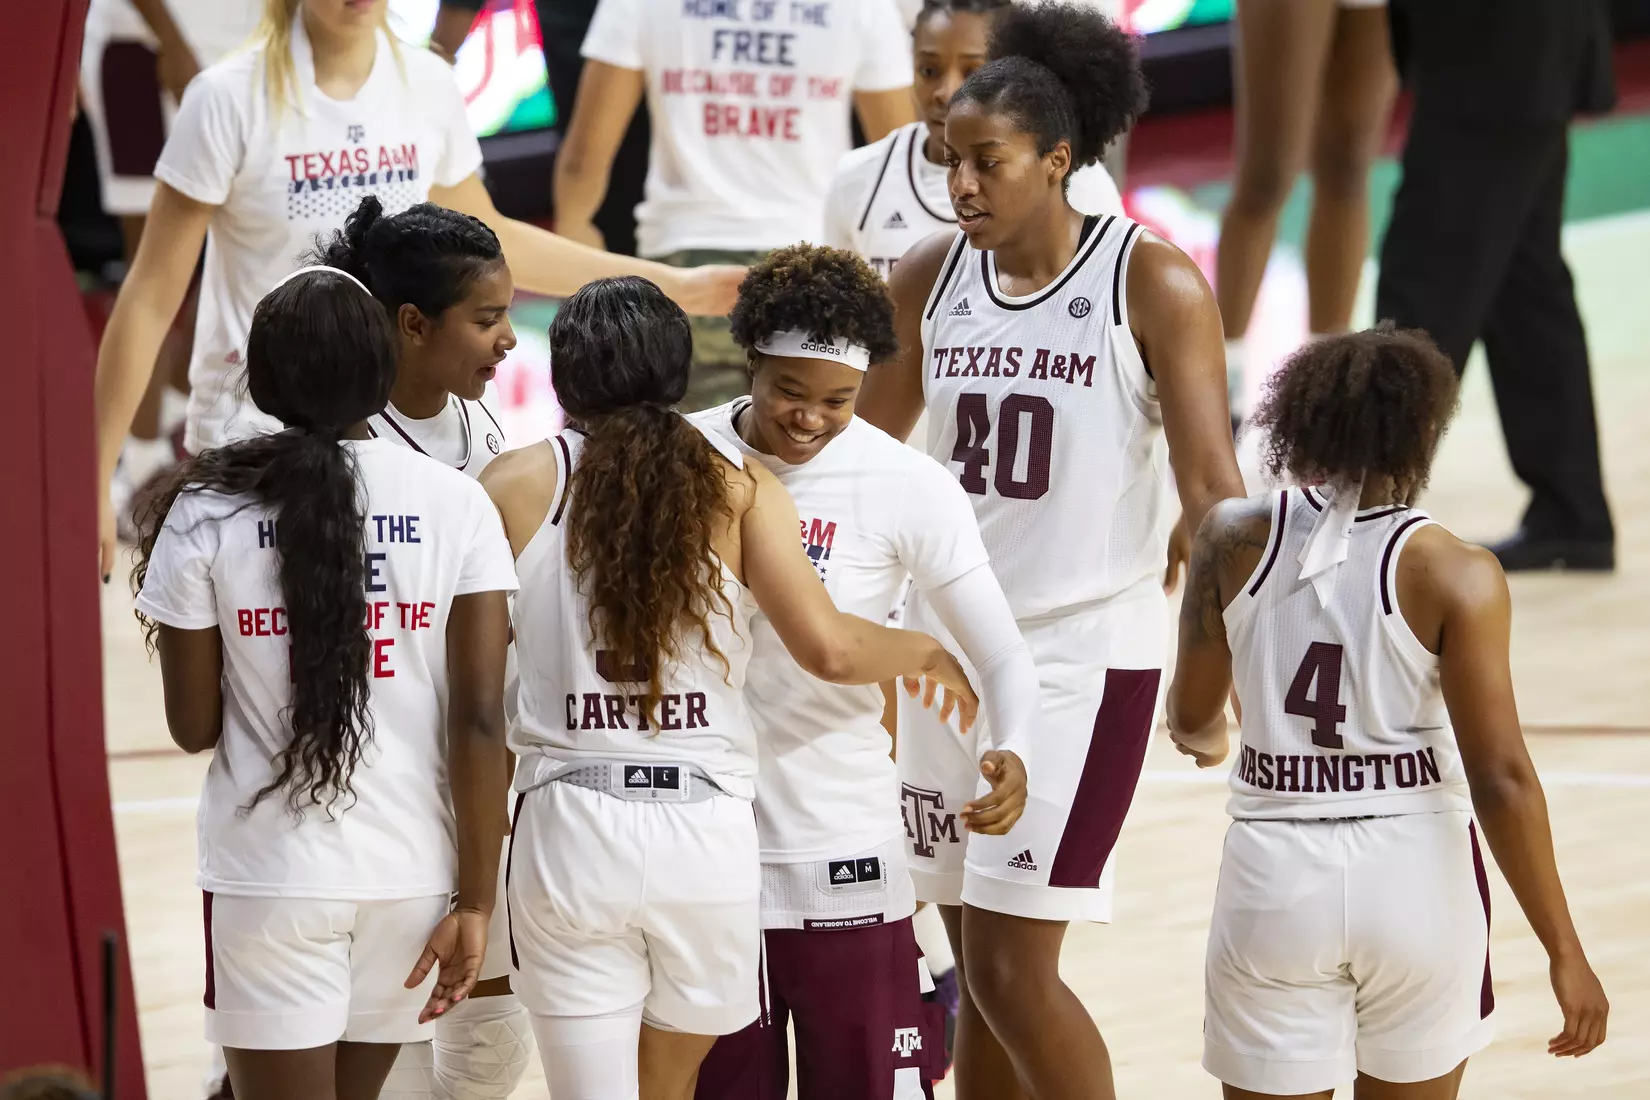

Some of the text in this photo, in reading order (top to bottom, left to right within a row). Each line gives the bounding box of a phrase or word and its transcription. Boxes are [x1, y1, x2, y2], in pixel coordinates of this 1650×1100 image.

[712, 29, 796, 66] FREE
[769, 74, 796, 97] OF
[703, 102, 802, 141] BRAVE
[284, 144, 418, 181] TEXAS A&M
[949, 308, 972, 317] adidas
[801, 342, 841, 356] adidas
[934, 347, 1097, 387] TEXAS A&M
[951, 393, 1055, 500] 40
[372, 515, 421, 543] THE
[396, 602, 436, 630] THE
[1284, 641, 1346, 750] 4
[566, 692, 709, 731] CARTER
[663, 772, 669, 781] L
[1238, 741, 1441, 793] WASHINGTON
[834, 873, 854, 881] adidas
[864, 865, 872, 874] M
[1007, 860, 1038, 872] adidas
[811, 920, 843, 928] AGGIELAND
[853, 916, 878, 926] WELCOME
